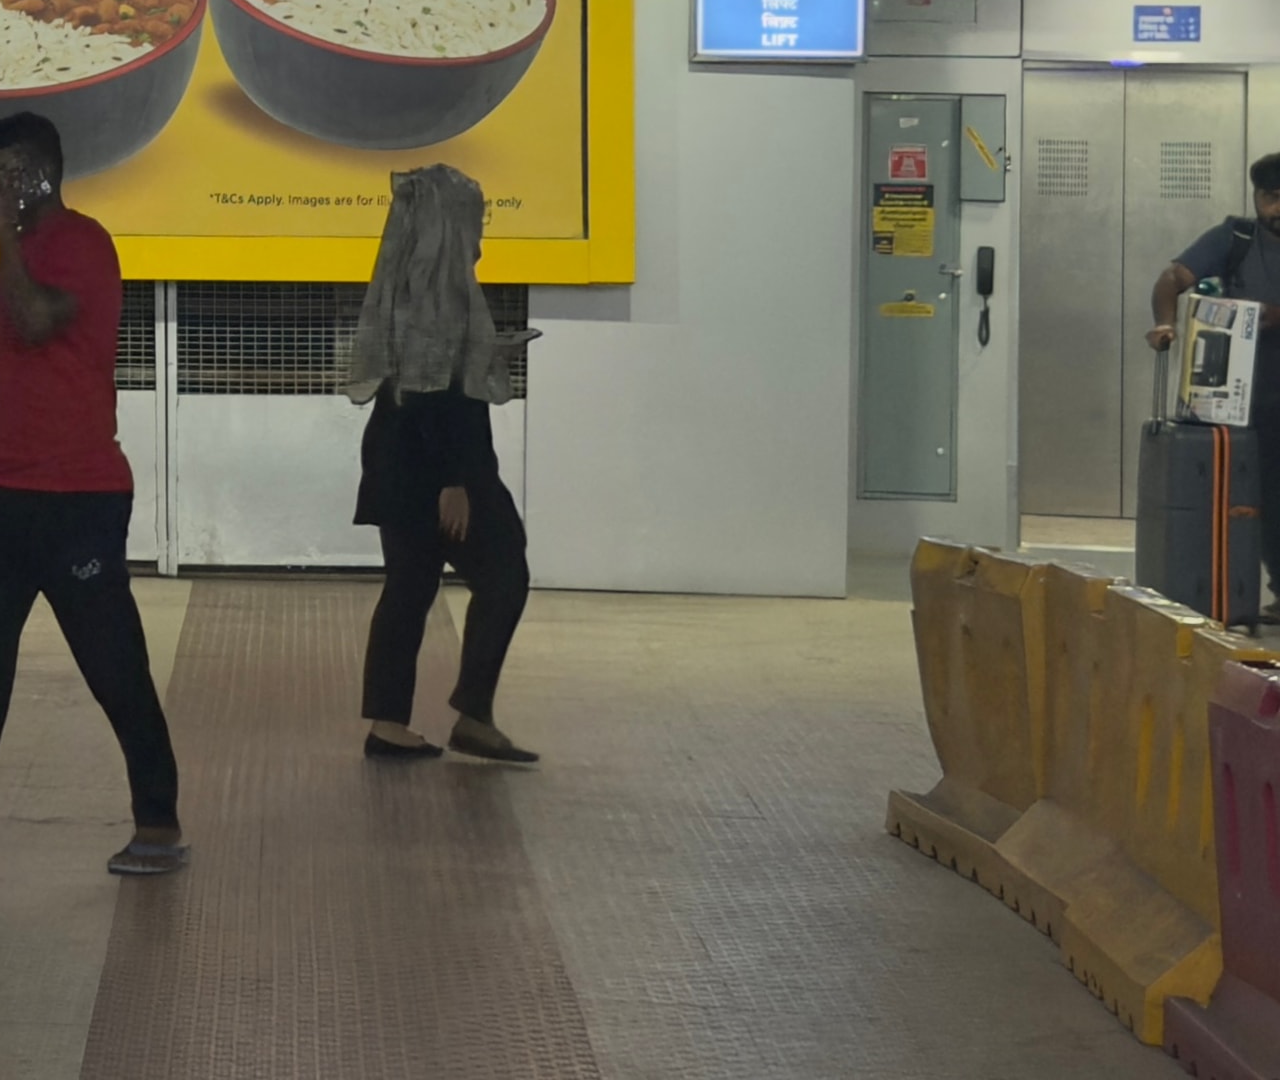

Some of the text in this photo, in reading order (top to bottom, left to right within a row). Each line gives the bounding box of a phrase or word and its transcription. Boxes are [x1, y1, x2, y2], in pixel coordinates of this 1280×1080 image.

[760, 32, 800, 47] LIFT
[248, 195, 285, 207] Apply.
[288, 196, 331, 207] Images
[335, 197, 353, 207] are
[356, 196, 374, 206] for
[496, 197, 525, 210] only.
